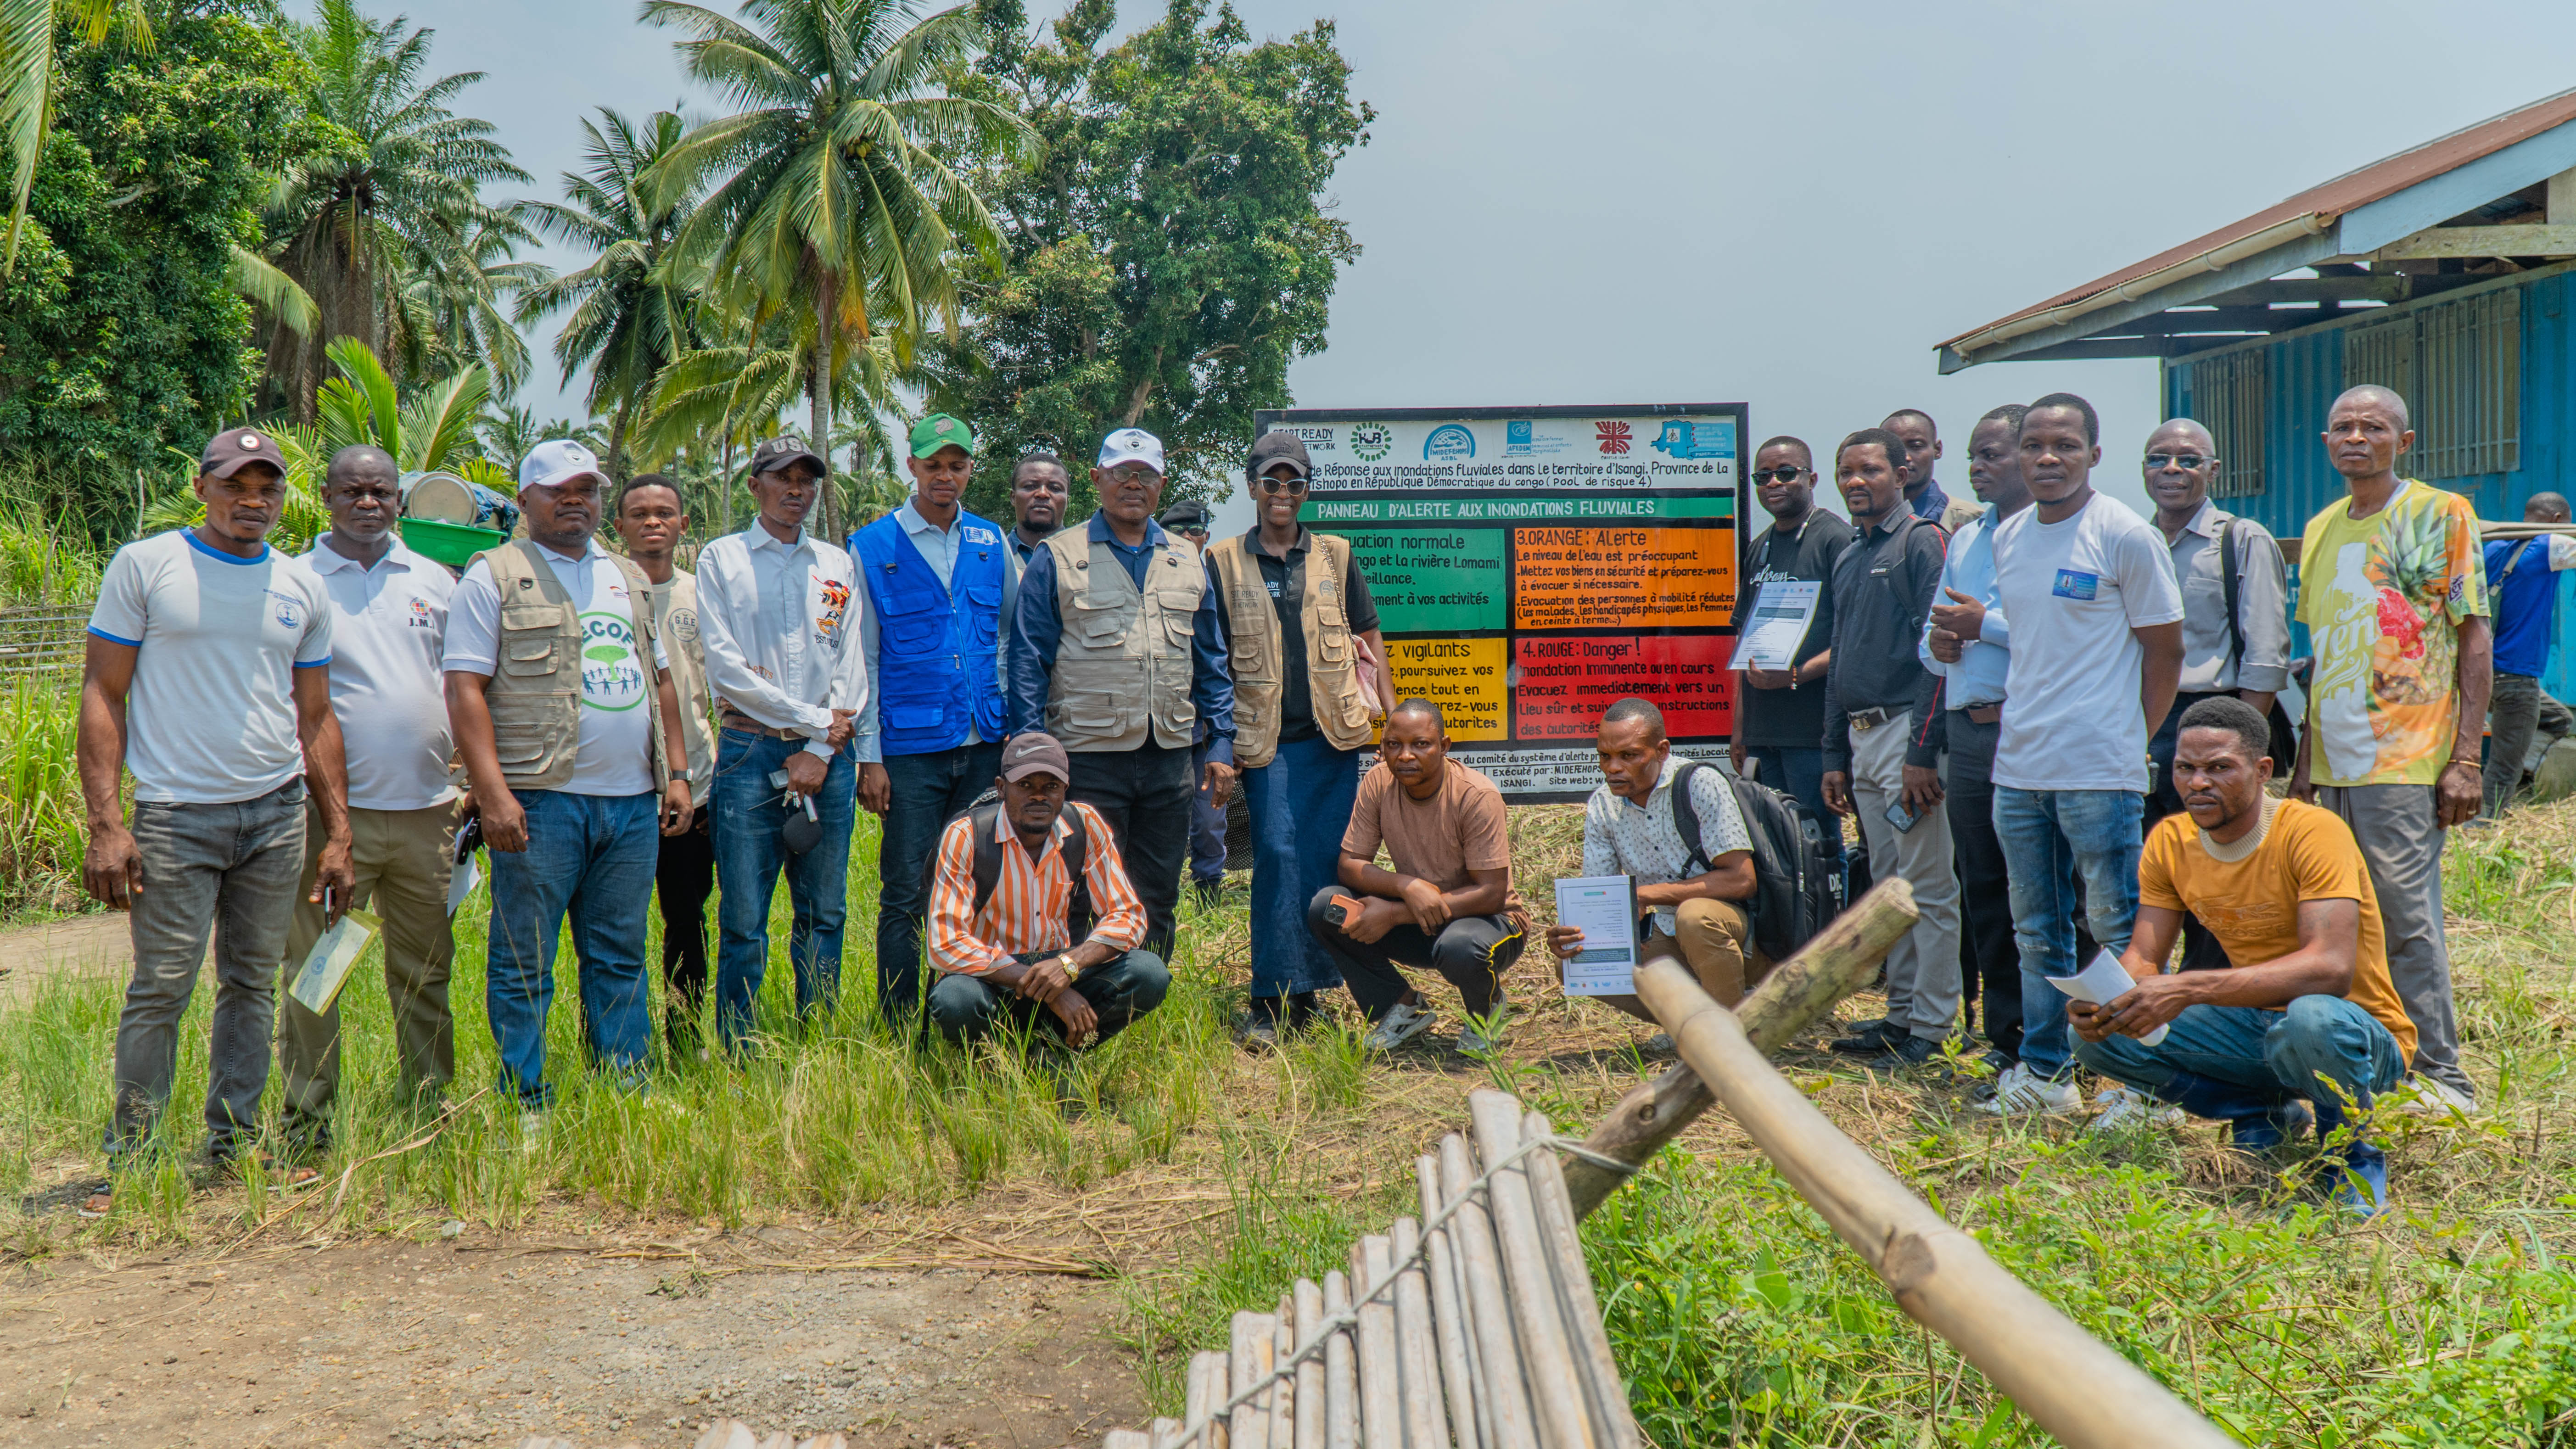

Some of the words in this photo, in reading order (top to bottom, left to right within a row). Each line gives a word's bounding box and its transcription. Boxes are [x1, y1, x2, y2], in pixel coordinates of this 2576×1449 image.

[1302, 428, 1333, 439] READY
[1325, 462, 1370, 478] Réponse
[1373, 465, 1391, 476] aux
[1508, 463, 1534, 475] dans
[1552, 463, 1603, 475] territoire
[1607, 463, 1648, 478] d'Isangi.
[1652, 461, 1699, 475] Province
[1702, 462, 1713, 474] de
[1311, 478, 1347, 490] Tshopo
[1351, 480, 1362, 488] en
[1365, 476, 1423, 490] République
[1427, 476, 1495, 489] Démocratique
[1499, 477, 1511, 487] du
[1585, 477, 1597, 486] de
[1602, 477, 1635, 489] risque
[1318, 503, 1378, 519] PANNEAU
[1389, 502, 1452, 518] D'ALERTE
[1457, 503, 1483, 517] AUX
[1488, 502, 1573, 516] INONDATIONS
[1580, 500, 1655, 515] FLUVIALES
[1337, 534, 1394, 549] uation
[1401, 534, 1465, 550] normale
[1355, 555, 1377, 570] ngo
[1379, 554, 1393, 566] et
[1411, 554, 1450, 568] rivière
[1453, 556, 1500, 569] Lomami
[1516, 549, 1530, 562] Le
[1533, 549, 1562, 561] niveau
[1566, 549, 1577, 561] de
[1579, 549, 1602, 561] l'eau
[1606, 550, 1623, 561] est
[1629, 549, 1698, 564] préoccupant
[1364, 572, 1417, 585] eillance.
[1556, 567, 1570, 576] vos
[1572, 565, 1593, 576] biens
[1595, 568, 1605, 576] en
[1607, 565, 1646, 576] sécurité
[1648, 567, 1658, 577] et
[1661, 566, 1728, 579] préparez-vous
[1521, 580, 1527, 591] à
[1530, 579, 1569, 591] évacuer
[1573, 579, 1581, 589] si
[1584, 578, 1643, 590] nécessaire.
[1407, 591, 1415, 605] à
[1417, 594, 1436, 605] vos
[1439, 591, 1490, 605] activités
[1578, 595, 1595, 605] des
[1598, 595, 1647, 607] personnes
[1650, 592, 1657, 603] à
[1659, 591, 1697, 602] mobilité
[1594, 604, 1641, 617] handicapés
[1574, 615, 1580, 625] à
[1583, 642, 1632, 661] Danger
[2311, 614, 2380, 685] Zen
[1400, 664, 1468, 679] poursuivez
[1473, 666, 1494, 676] vos
[1519, 662, 1581, 677] Inondation
[1650, 664, 1662, 675] ou
[1664, 664, 1677, 675] en
[1681, 664, 1715, 675] cours
[1431, 683, 1459, 695] tout
[1464, 685, 1480, 695] en
[1518, 684, 1568, 697] Evacuez
[1675, 683, 1703, 694] vers
[1708, 683, 1725, 694] un
[1437, 701, 1498, 712] arez-vous
[1546, 700, 1568, 714] sûr
[1571, 703, 1584, 714] et
[1587, 700, 1612, 713] suiv
[1521, 723, 1542, 736] des
[1547, 720, 1601, 735] autorités
[1464, 754, 1475, 764] du
[1477, 753, 1506, 764] comité
[1509, 754, 1519, 763] du
[1520, 752, 1557, 765] système
[1559, 751, 1589, 762] d'alerte
[1669, 748, 1700, 757] torités
[1702, 748, 1730, 757] Locale
[1493, 766, 1532, 777] Exécuté
[1549, 777, 1567, 785] Site
